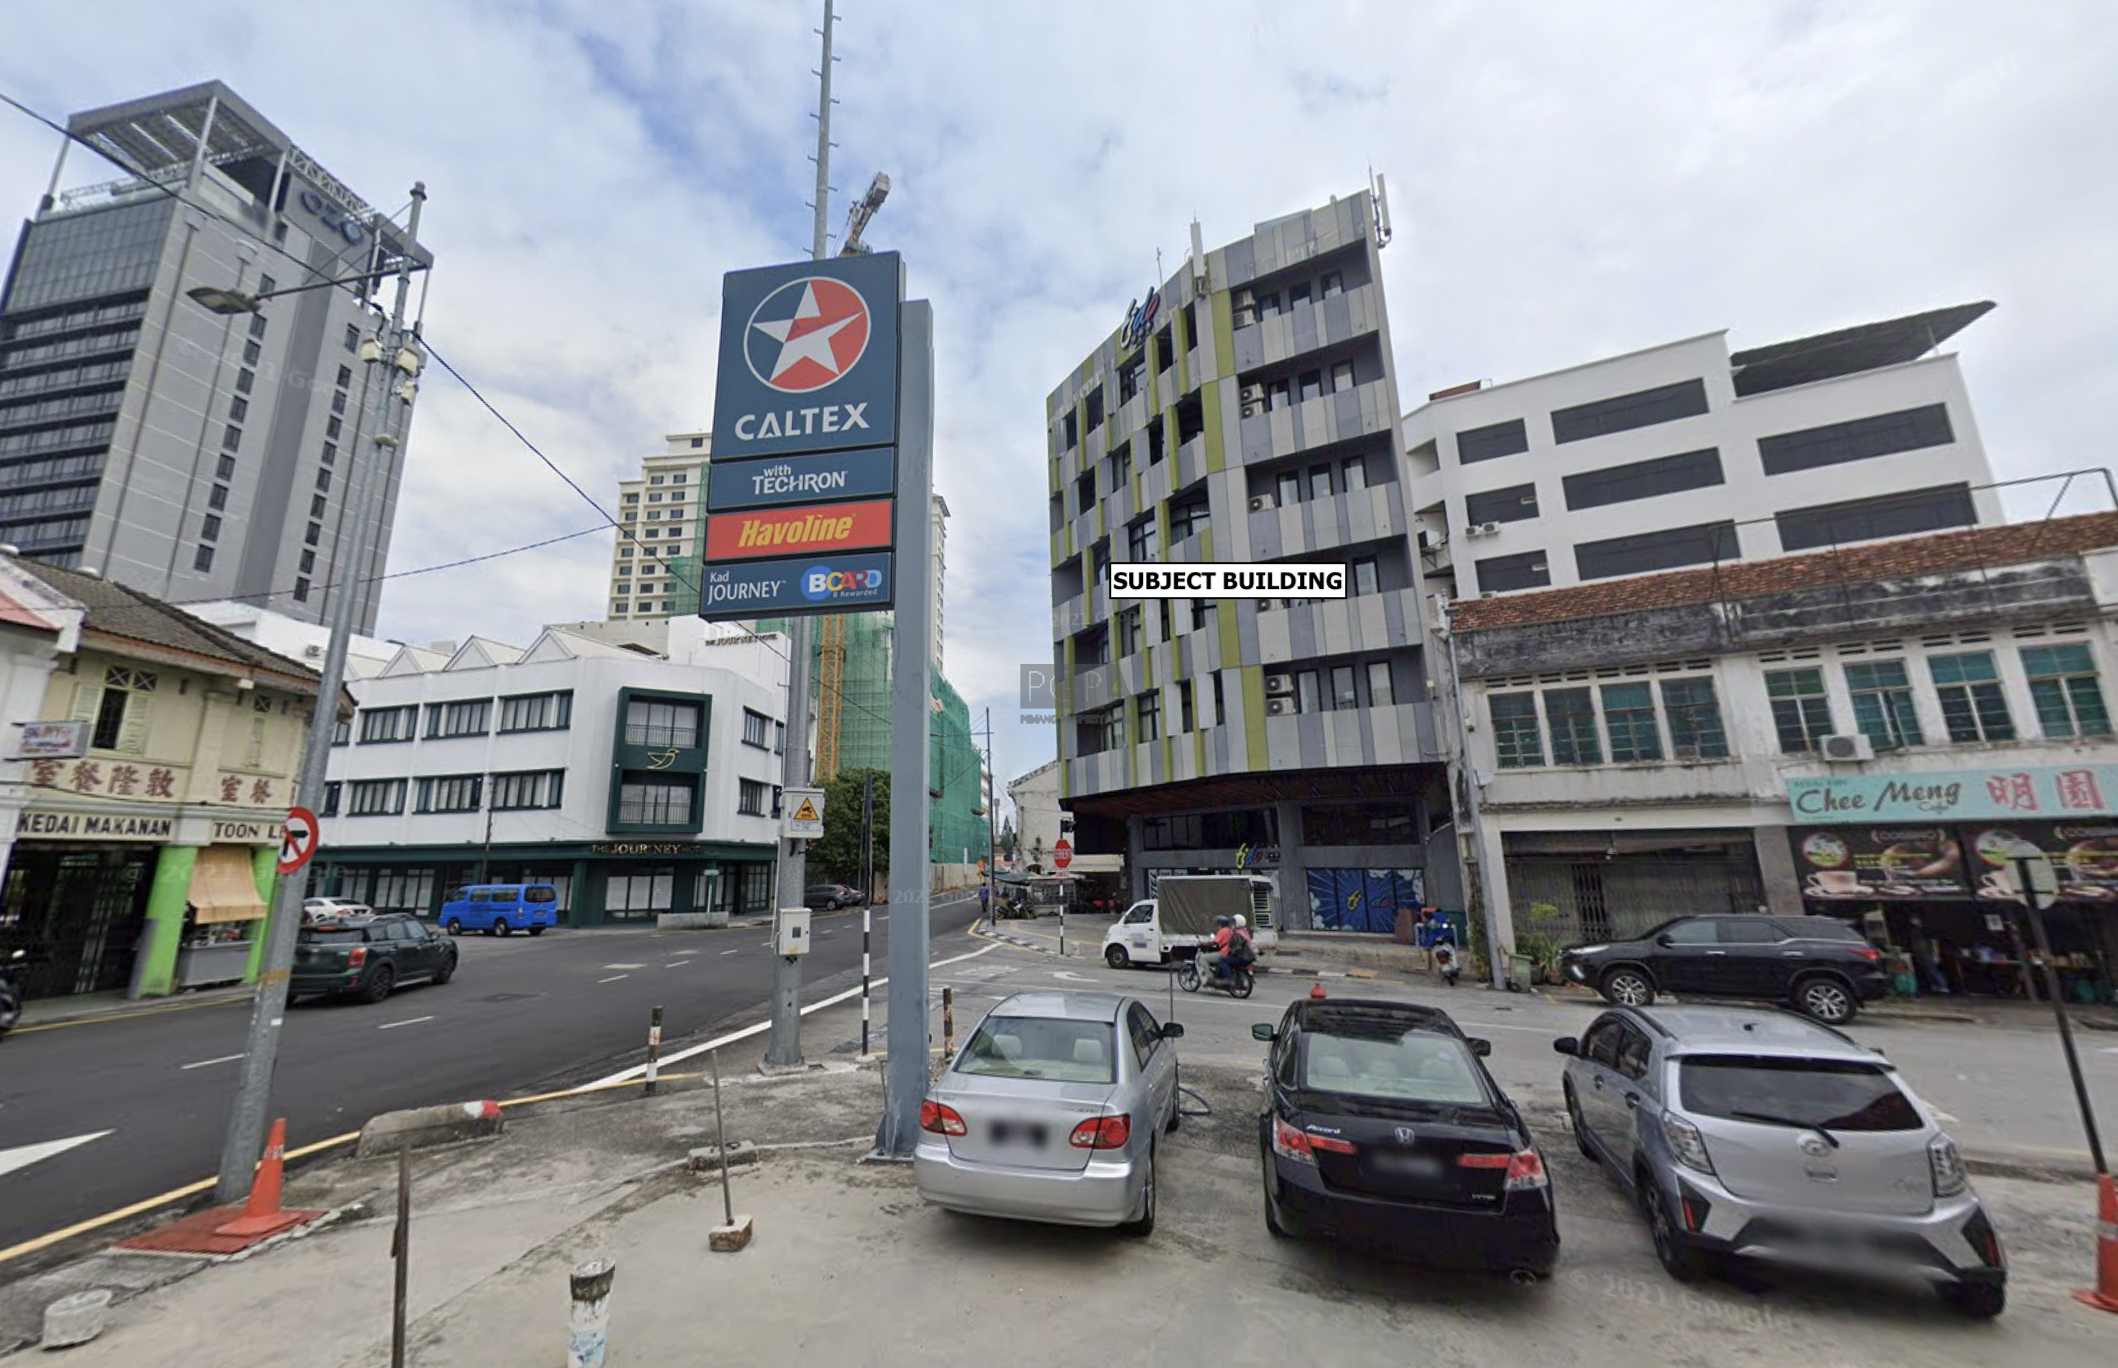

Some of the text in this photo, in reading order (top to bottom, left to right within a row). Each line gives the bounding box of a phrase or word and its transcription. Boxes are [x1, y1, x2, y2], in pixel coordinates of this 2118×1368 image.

[300, 191, 365, 245] OZO
[734, 402, 870, 441] CALTEX
[763, 464, 791, 477] with
[752, 471, 846, 498] TECHRON
[738, 514, 853, 548] Havoline
[710, 571, 730, 583] Kad
[808, 569, 882, 593] BCARD
[707, 581, 781, 605] JOURNEY
[840, 588, 877, 598] Rewarded
[1796, 781, 1961, 814] Chee Meng
[16, 813, 172, 836] KEDAI MAKANAN
[214, 822, 260, 839] TOON
[1306, 1123, 1341, 1135] Accord
